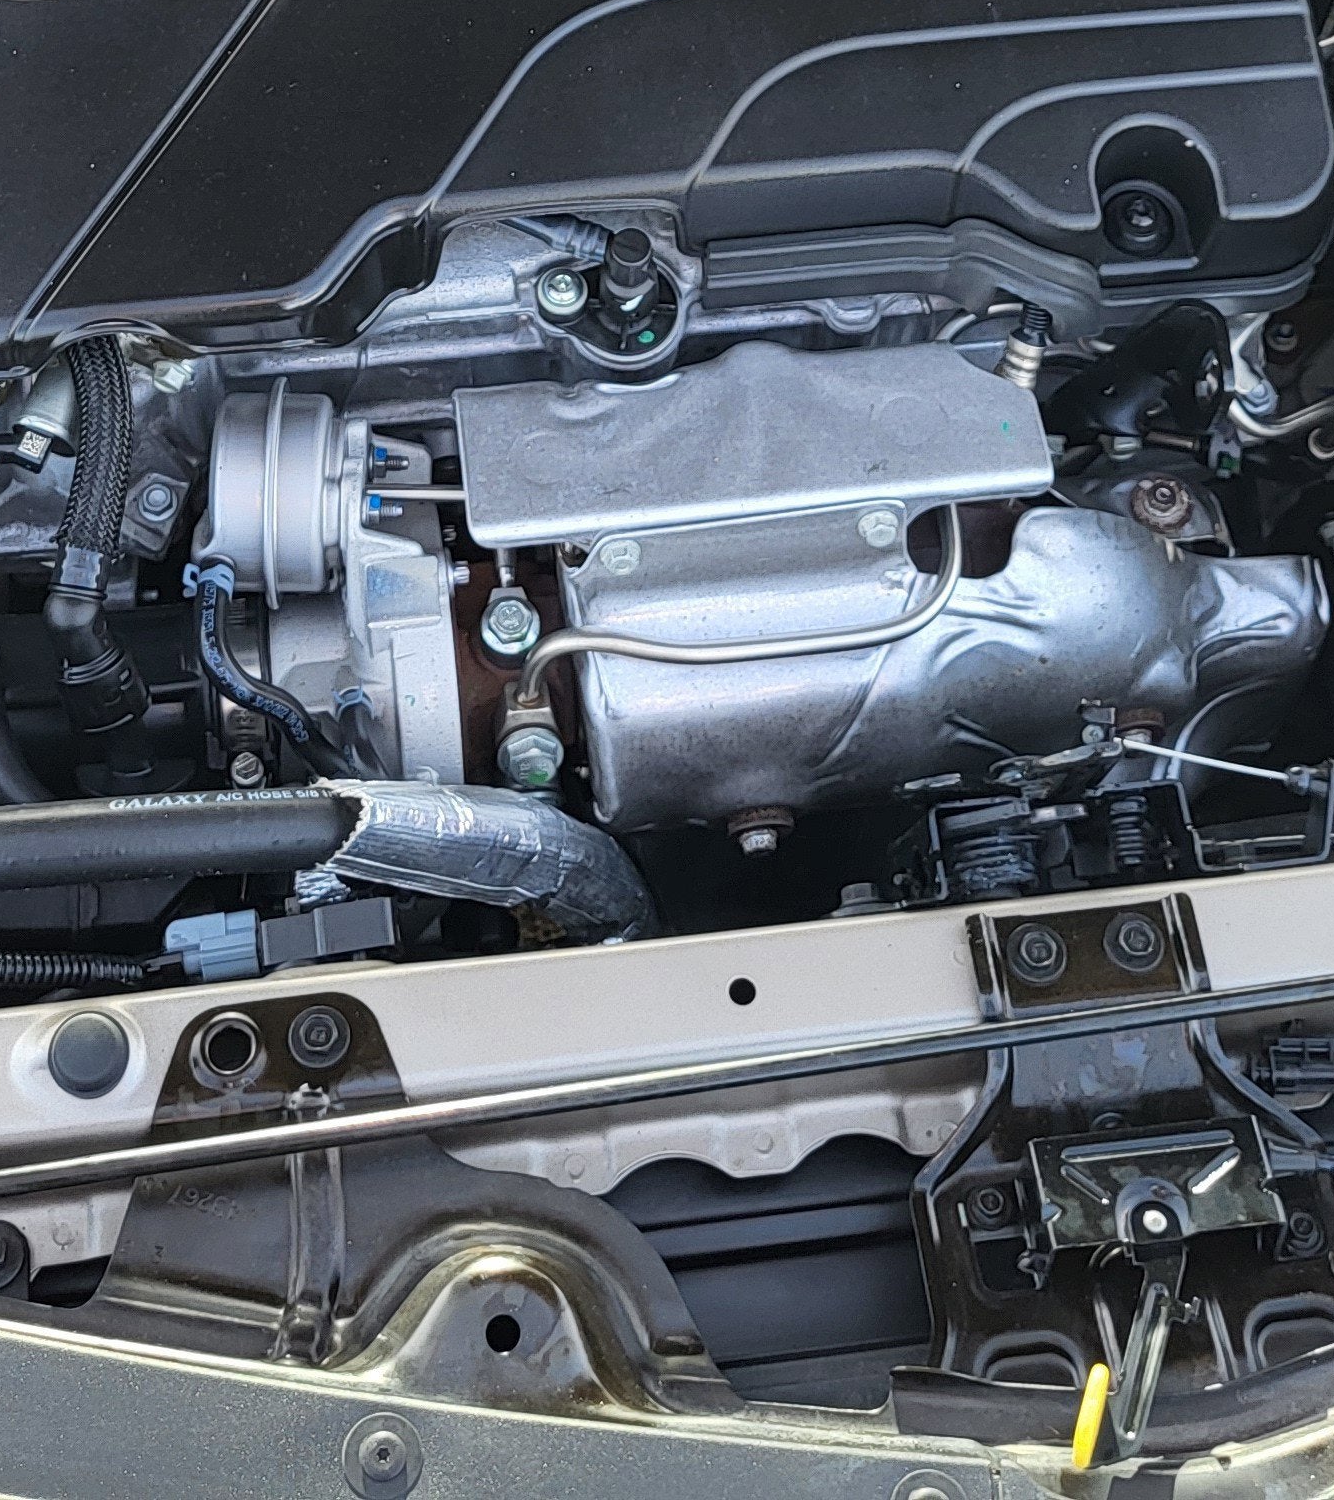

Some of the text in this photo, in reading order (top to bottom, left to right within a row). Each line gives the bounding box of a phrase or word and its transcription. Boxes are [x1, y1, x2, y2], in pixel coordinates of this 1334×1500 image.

[109, 793, 208, 810] GALAXY
[217, 791, 244, 802] A/C
[247, 789, 293, 801] HOSE
[296, 789, 319, 799] 5/8
